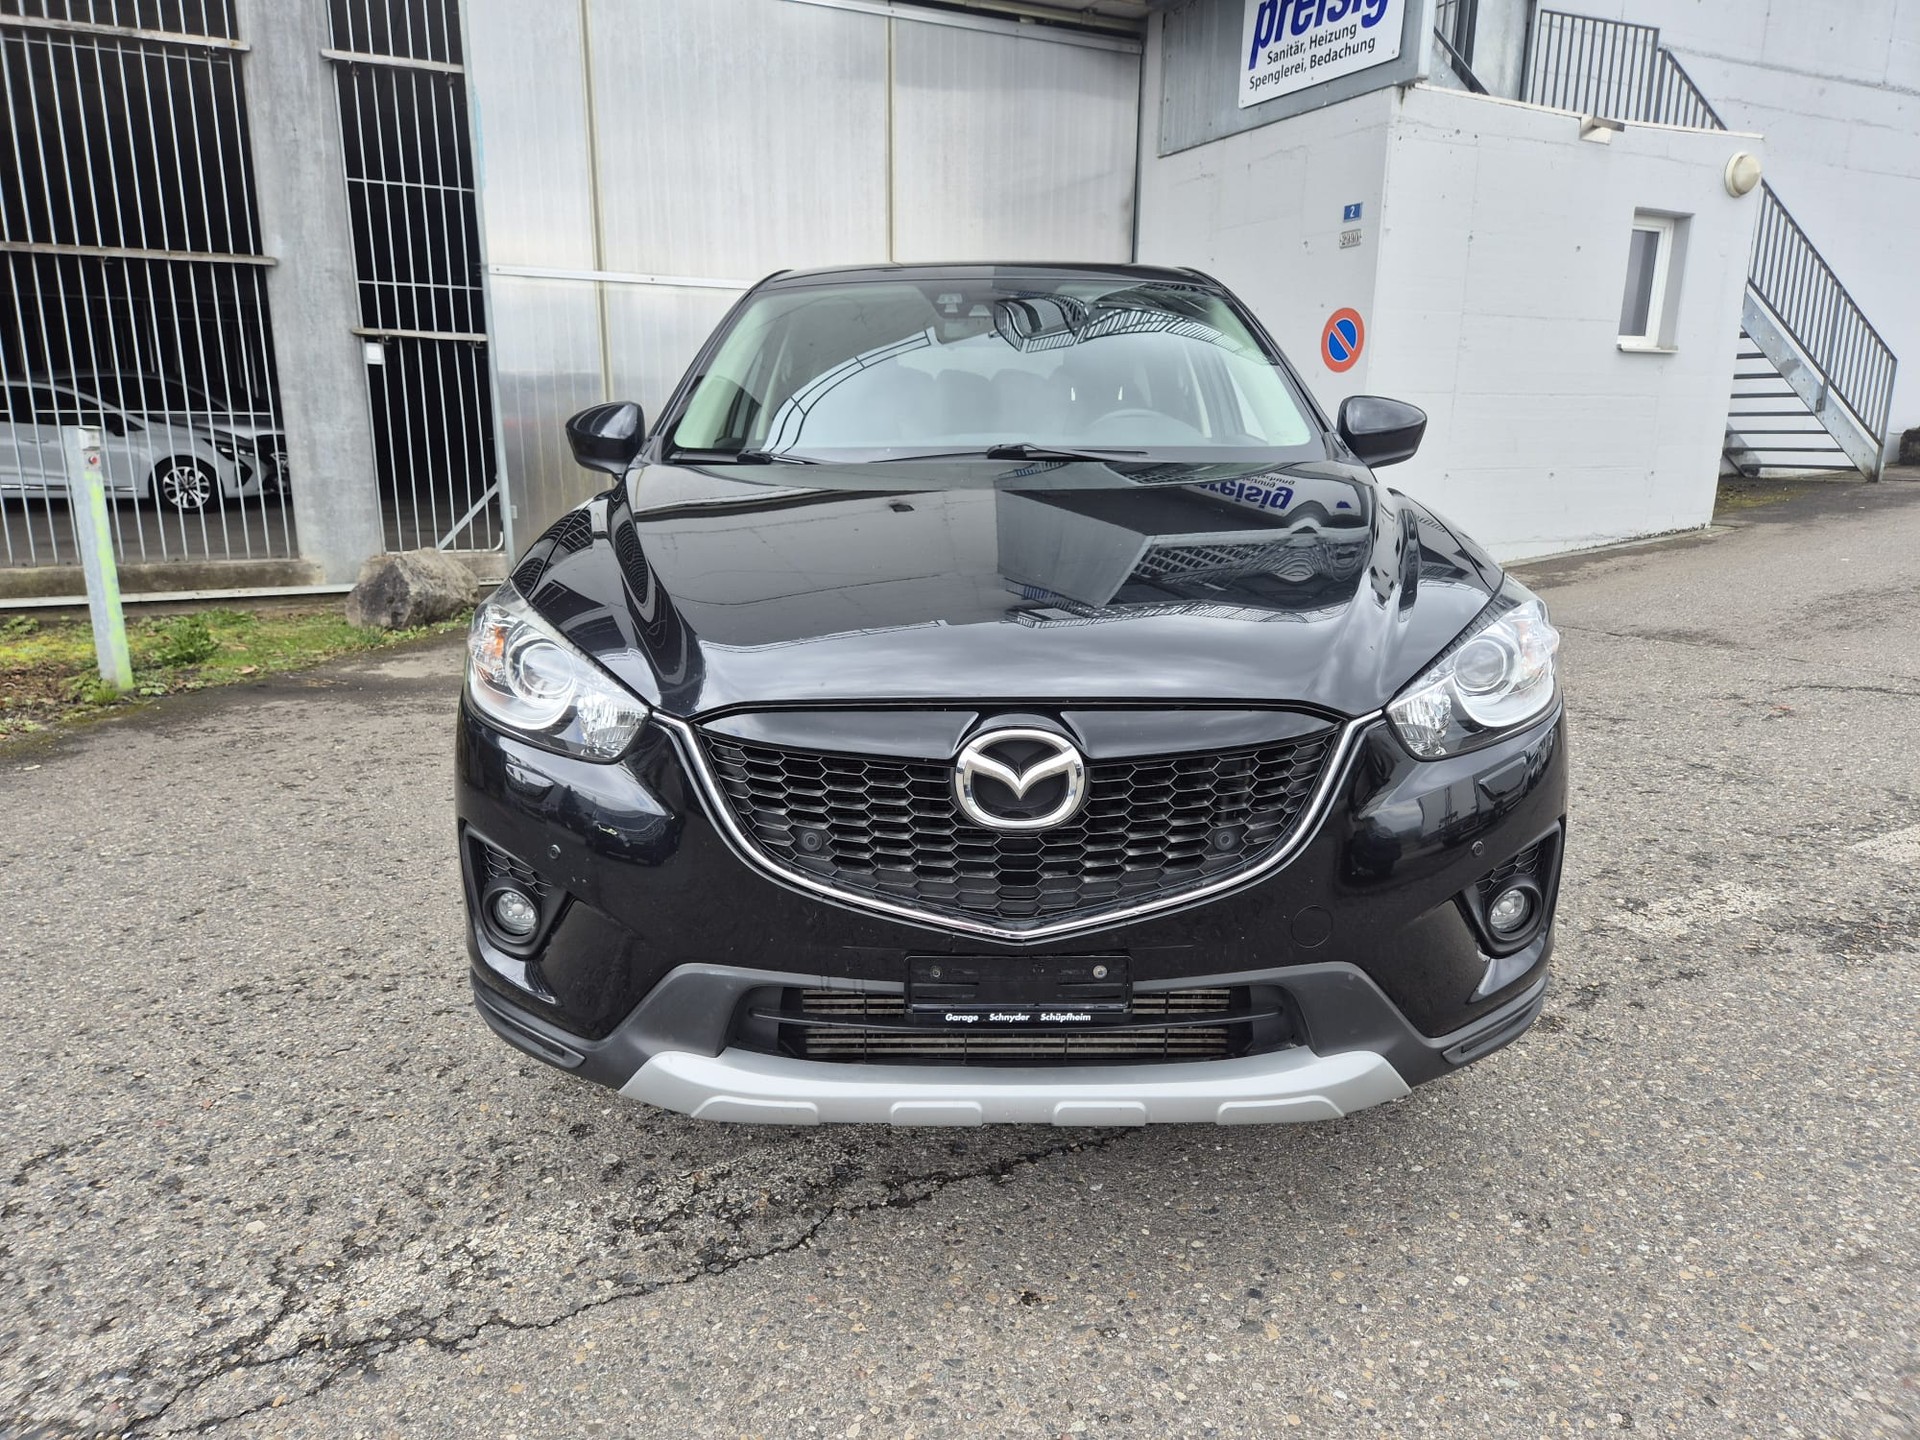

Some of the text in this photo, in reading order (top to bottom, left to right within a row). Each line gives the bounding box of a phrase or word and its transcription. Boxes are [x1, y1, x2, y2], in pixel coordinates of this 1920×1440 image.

[1267, 23, 1358, 65] Sanitär, Heizung
[1249, 37, 1376, 91] Spenglerei, Bedachung
[1350, 205, 1355, 218] 2
[945, 1013, 1092, 1023] Garage Schnyder Schüpfheim
